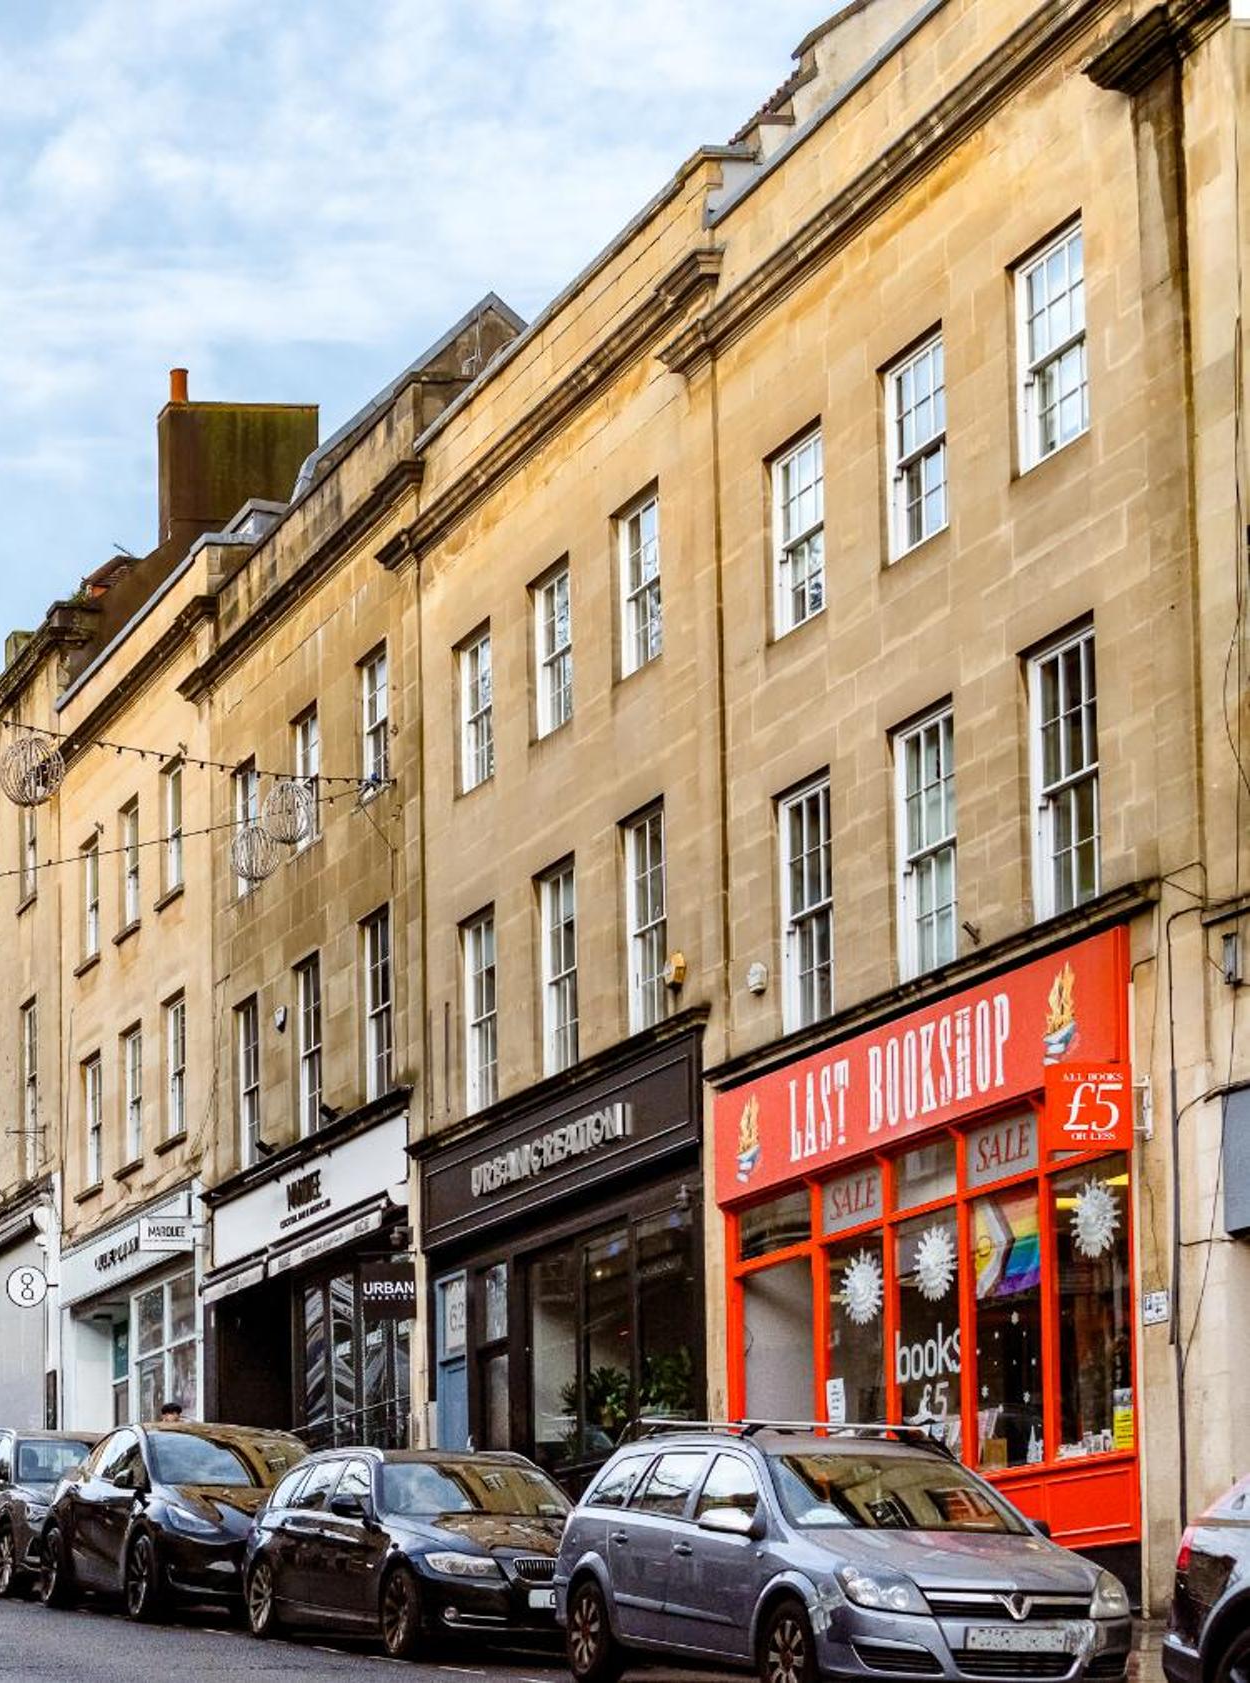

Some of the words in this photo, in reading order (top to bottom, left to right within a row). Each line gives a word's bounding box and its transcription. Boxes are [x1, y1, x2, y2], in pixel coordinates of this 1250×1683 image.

[789, 1058, 850, 1163] LAST
[867, 993, 1010, 1134] BOOKSHOP
[1063, 1072, 1082, 1081] ALL
[1087, 1071, 1124, 1081] BOOKS
[1062, 1082, 1123, 1132] £5
[976, 1120, 1031, 1173] SALE
[1070, 1132, 1086, 1141] OR
[1091, 1131, 1117, 1141] LESS
[830, 1172, 877, 1221] SALE
[363, 1280, 414, 1295] URBAN
[895, 1321, 961, 1385] books
[910, 1381, 949, 1425] £5
